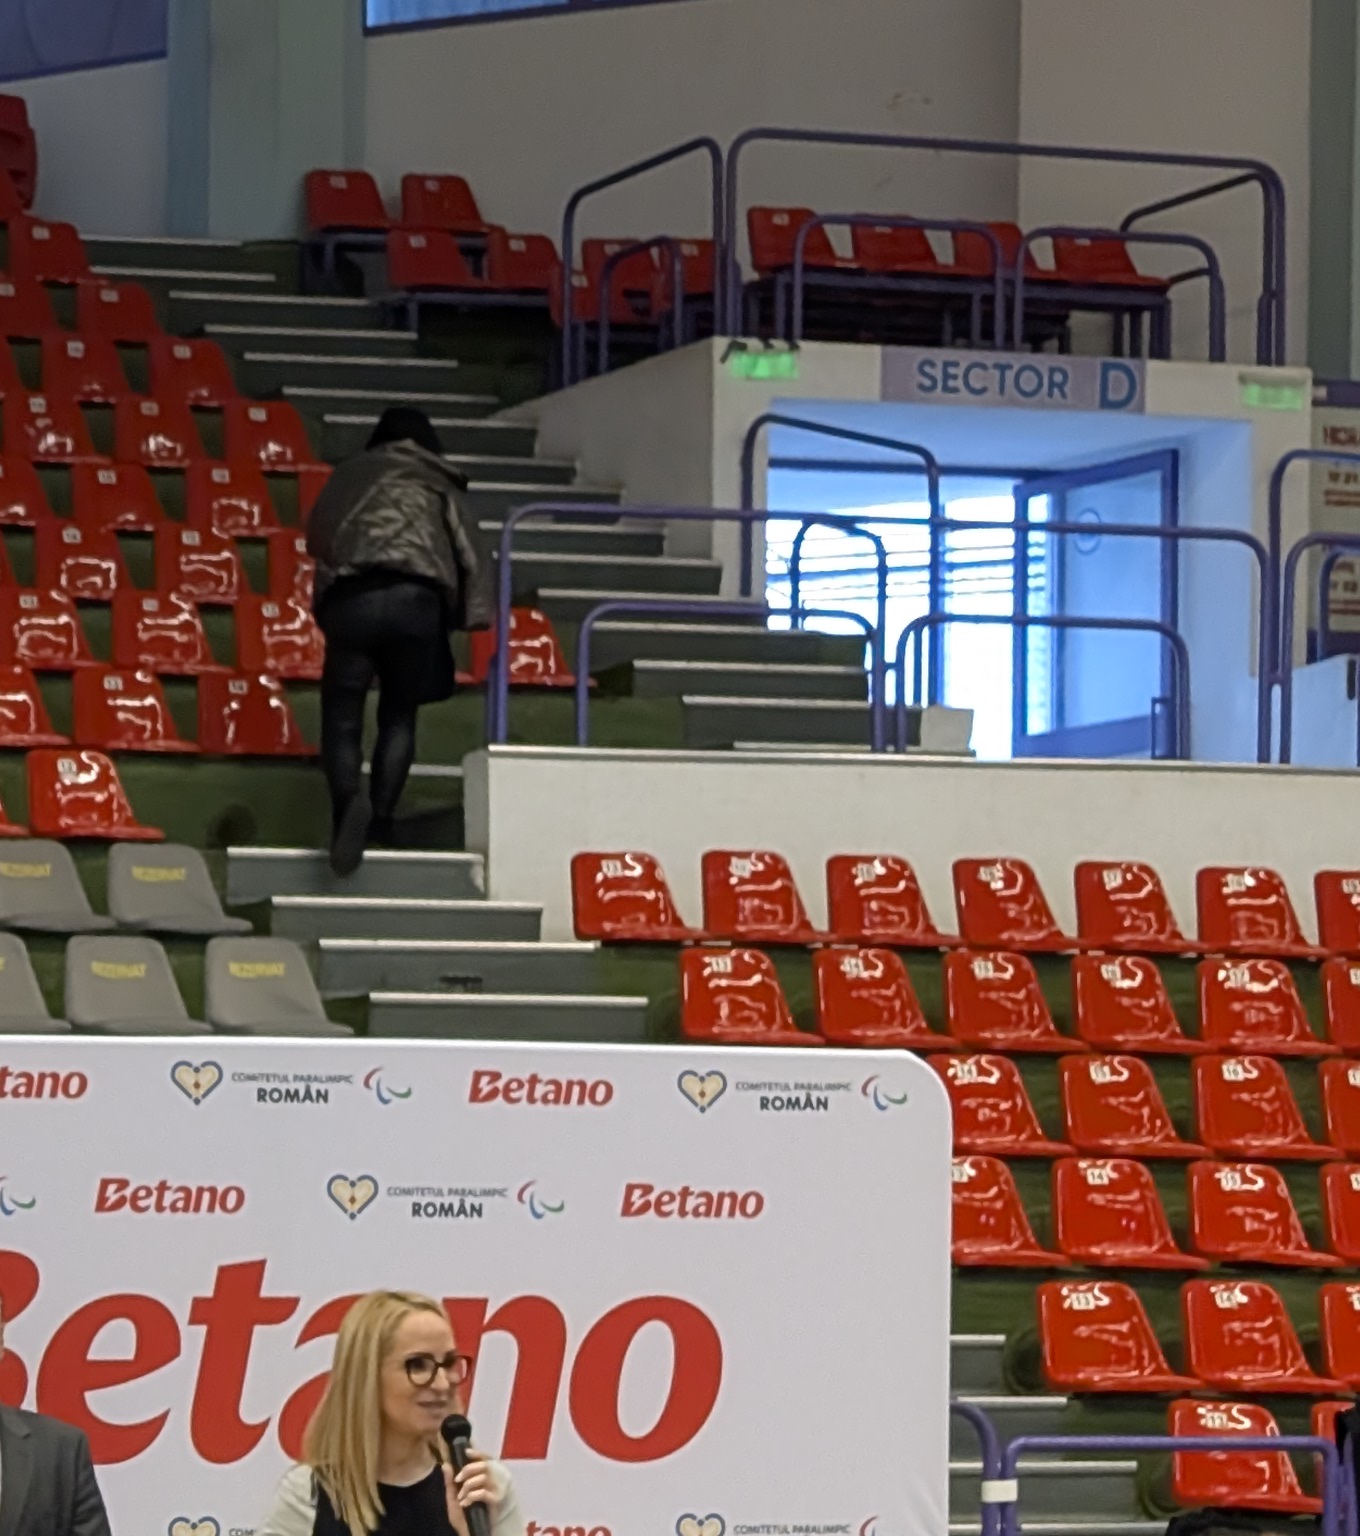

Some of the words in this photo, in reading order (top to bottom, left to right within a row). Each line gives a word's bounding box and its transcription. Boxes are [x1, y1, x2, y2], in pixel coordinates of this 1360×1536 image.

[917, 359, 1069, 399] SECTOR
[1100, 361, 1138, 410] D
[257, 1083, 328, 1103] ROMÂN
[469, 1070, 613, 1106] Betano
[760, 1092, 828, 1111] ROMÂN
[95, 1178, 245, 1213] Betano
[412, 1196, 482, 1218] ROMÂN
[621, 1183, 764, 1218] Betano
